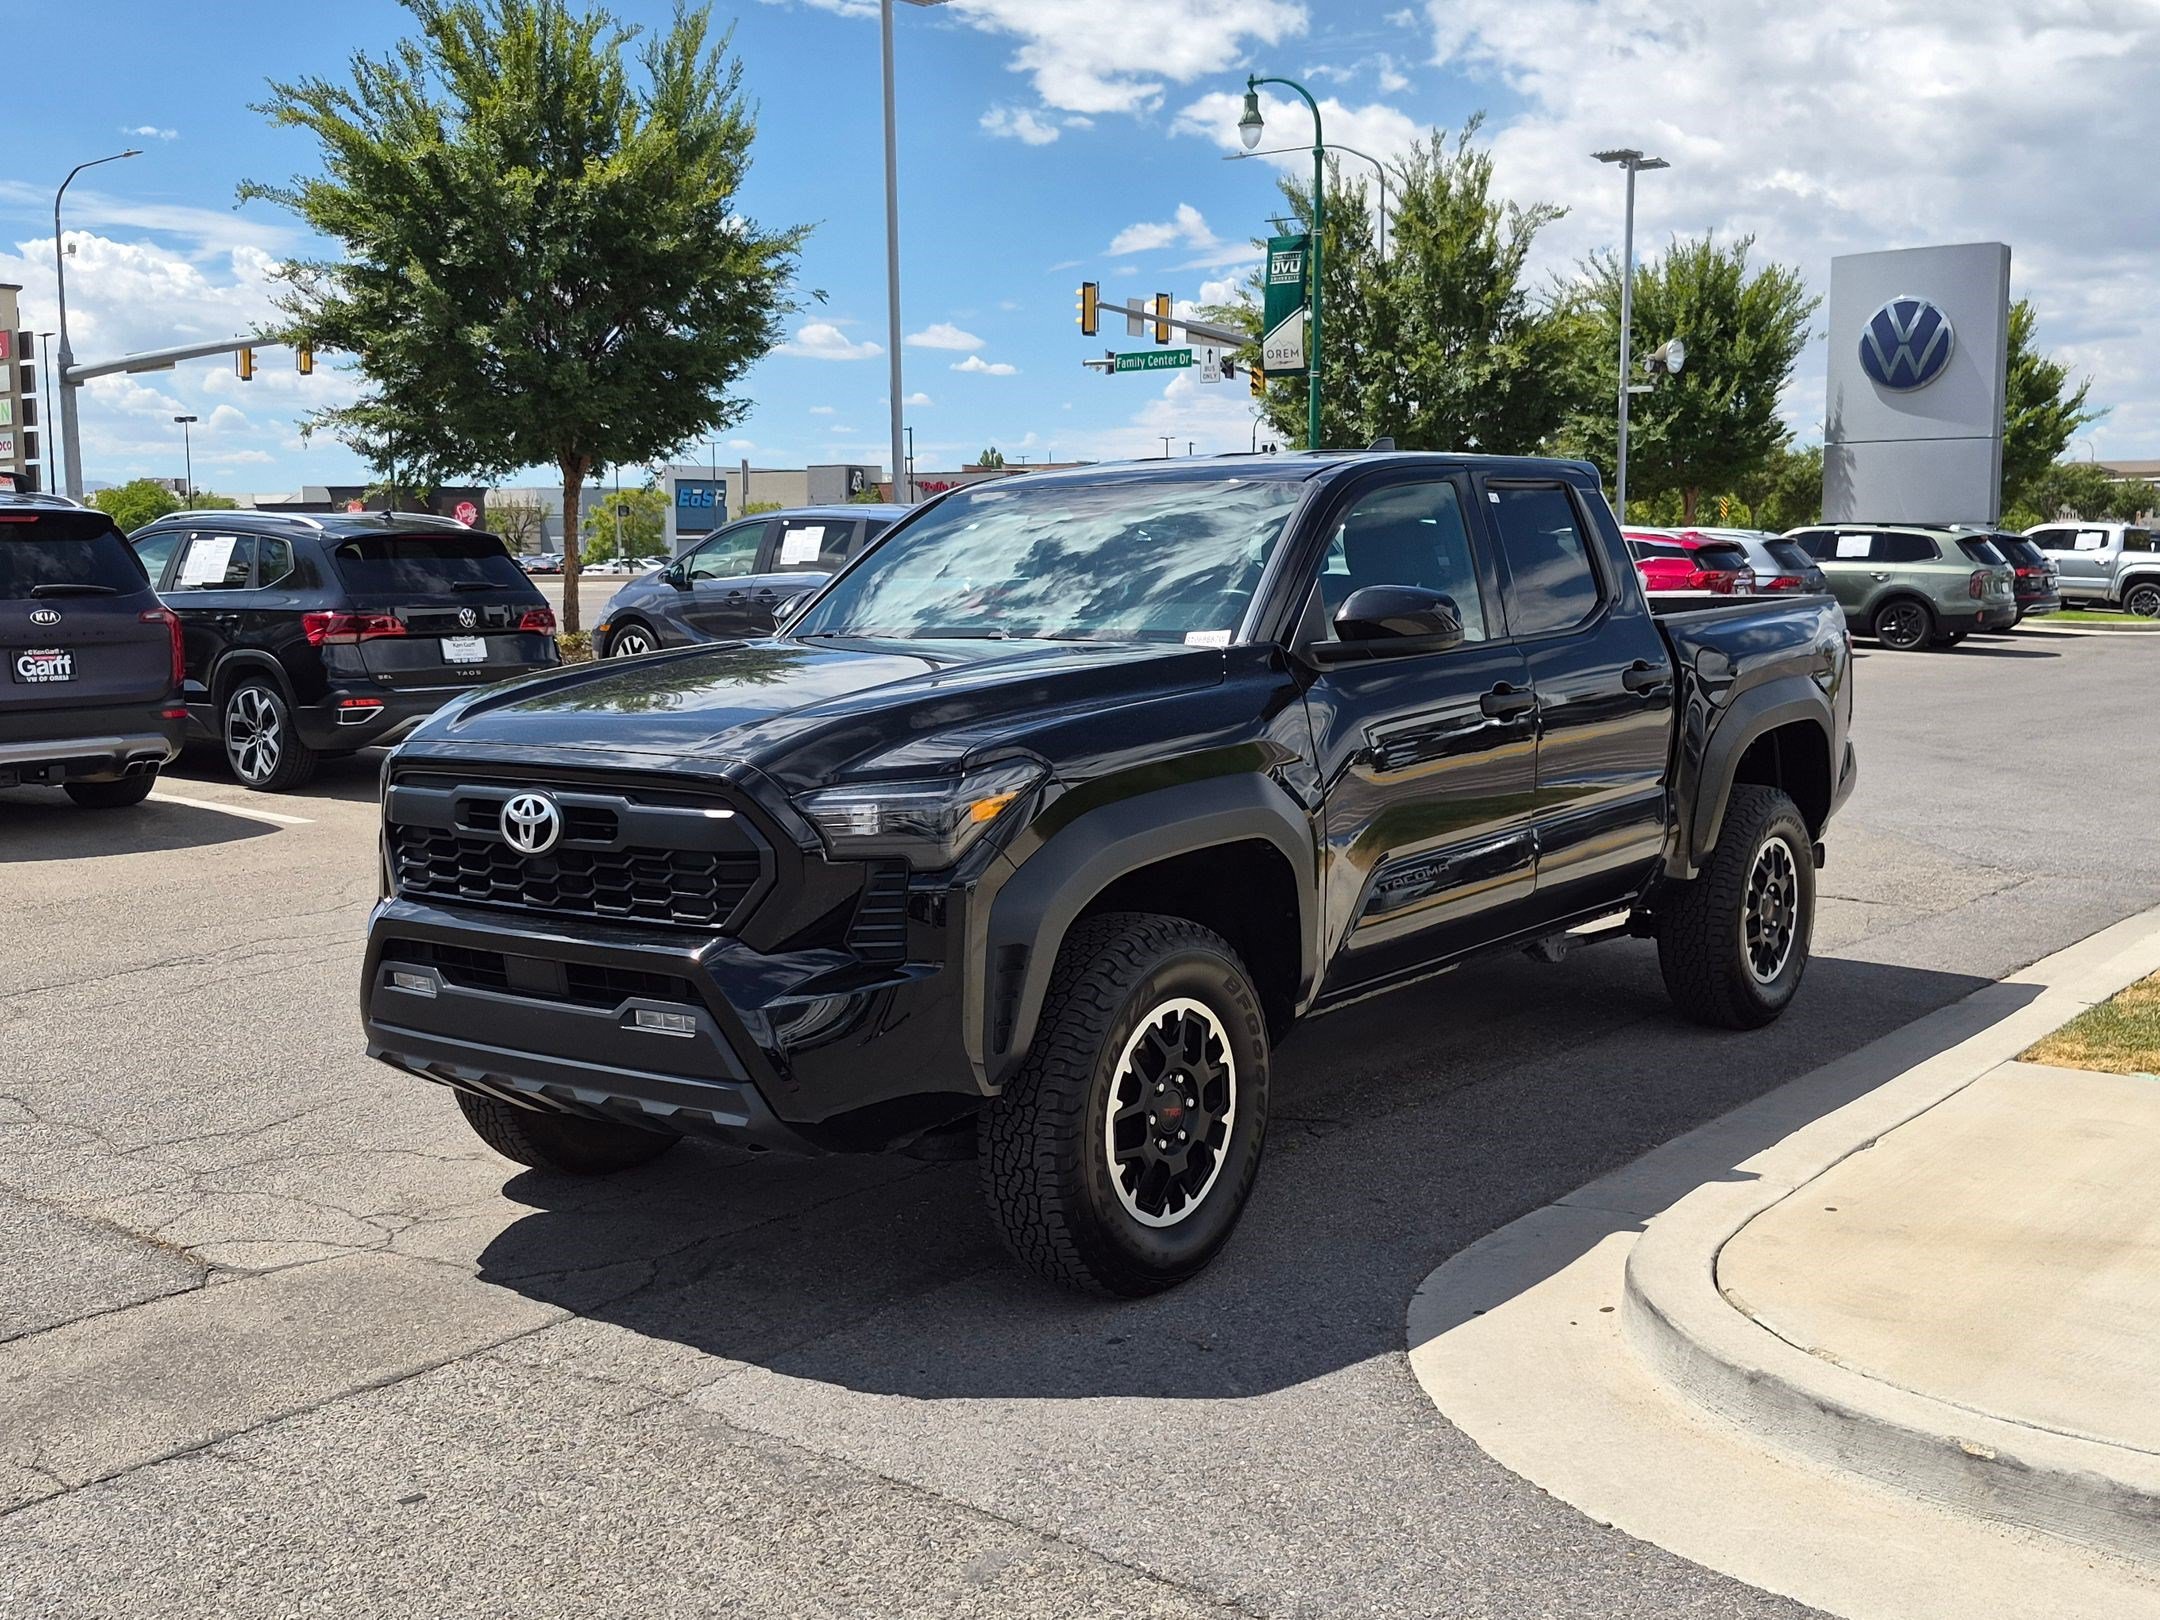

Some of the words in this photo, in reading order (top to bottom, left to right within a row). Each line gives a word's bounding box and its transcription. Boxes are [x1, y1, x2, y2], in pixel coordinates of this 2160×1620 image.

[1271, 260, 1301, 274] UVU
[1266, 348, 1300, 359] OREM
[1116, 357, 1146, 370] Family
[1147, 354, 1177, 367] Center
[1179, 353, 1190, 365] Dr
[1204, 364, 1216, 372] BUS
[34, 611, 57, 622] KIA
[17, 654, 72, 677] Garff
[1383, 862, 1451, 890] TACOMA
